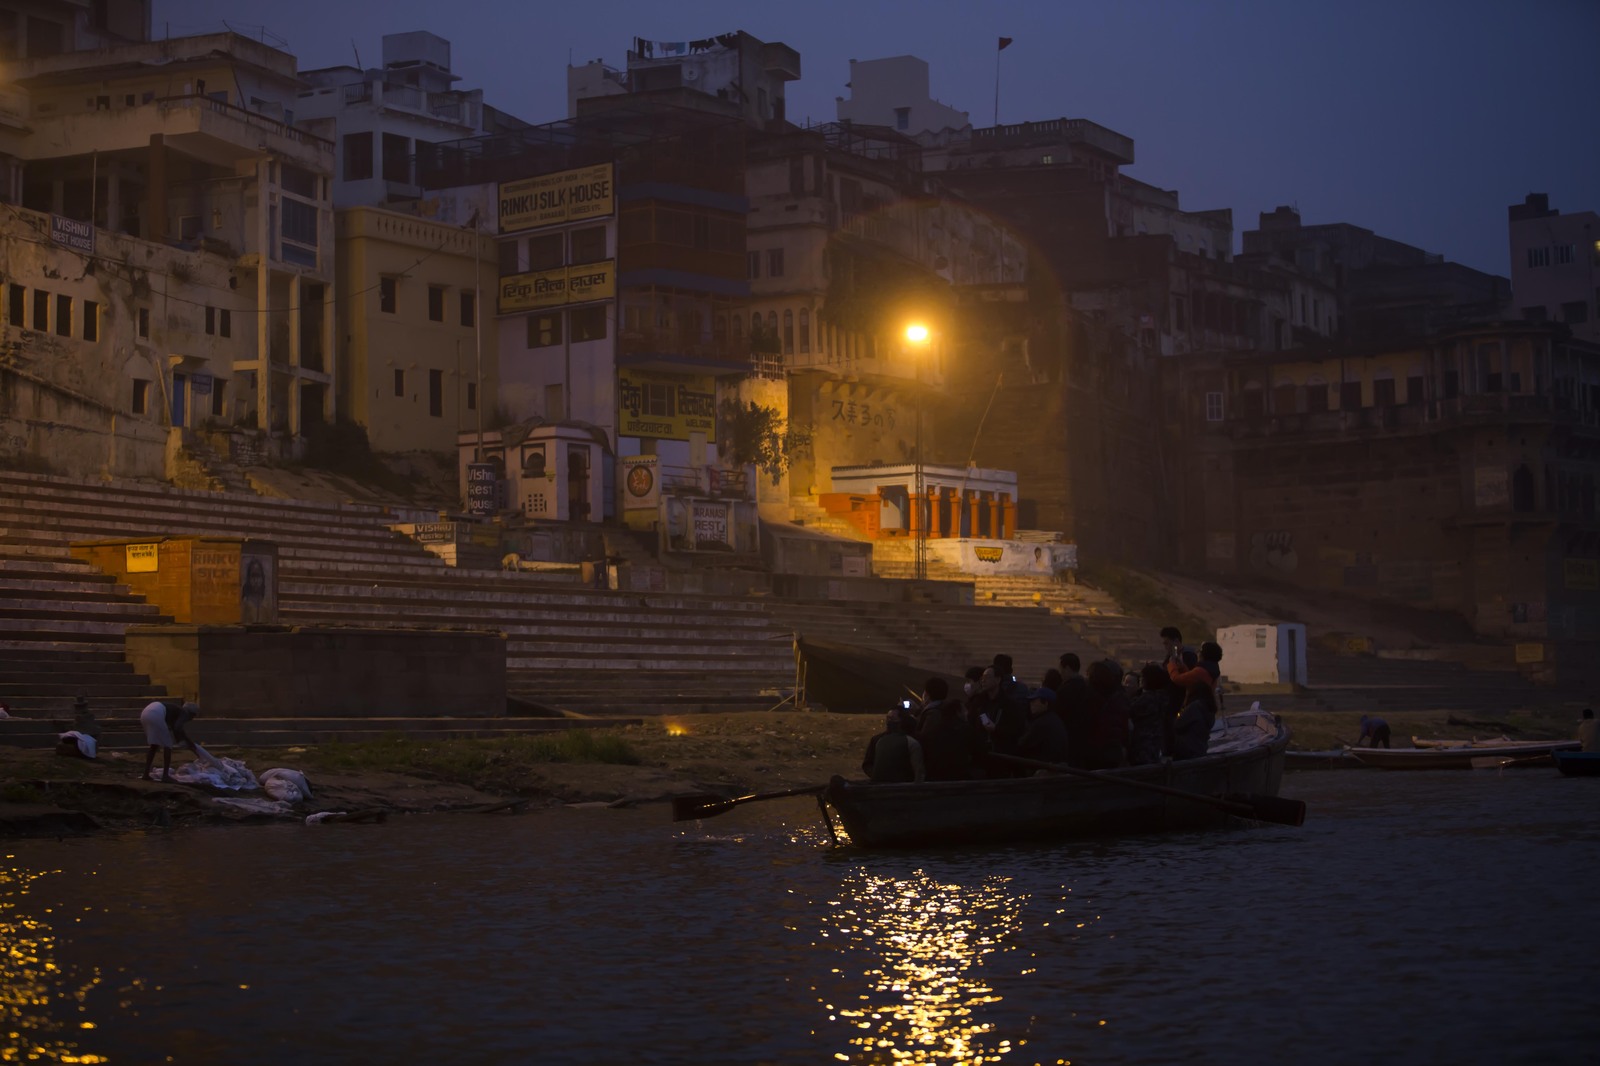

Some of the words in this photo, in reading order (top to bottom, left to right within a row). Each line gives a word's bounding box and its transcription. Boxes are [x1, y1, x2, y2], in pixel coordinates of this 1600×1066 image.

[501, 194, 538, 217] RINKU
[540, 187, 566, 210] SILK
[569, 181, 609, 204] HOUSE
[56, 217, 89, 237] VISHNU
[53, 230, 69, 244] REST
[70, 235, 92, 250] HOUSE
[570, 272, 607, 291] हाउस
[694, 520, 721, 531] REST
[193, 553, 239, 565] RINKU
